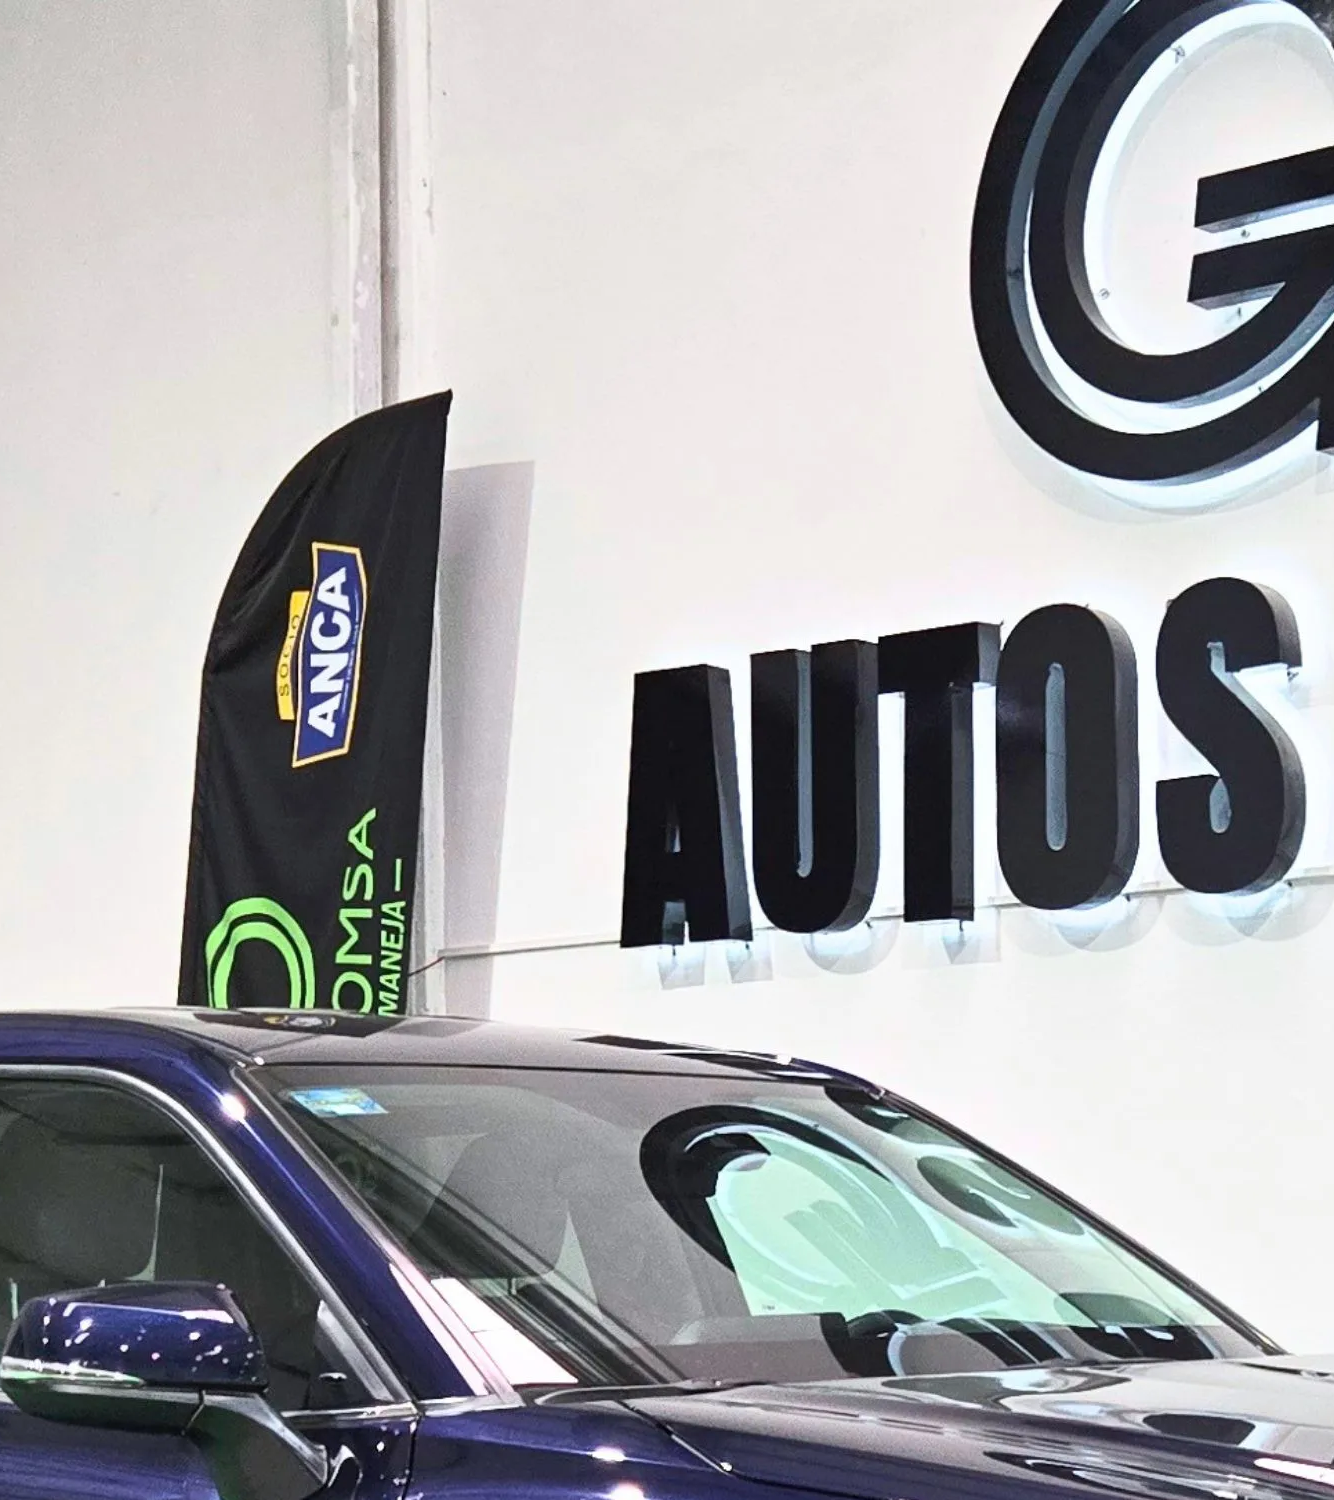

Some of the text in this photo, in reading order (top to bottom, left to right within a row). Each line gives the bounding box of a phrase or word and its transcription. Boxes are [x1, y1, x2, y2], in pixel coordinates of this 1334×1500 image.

[278, 613, 301, 698] SOCIO
[307, 566, 352, 739] ANCA
[620, 576, 1307, 948] AUTOS
[378, 900, 406, 1017] MANEJA
